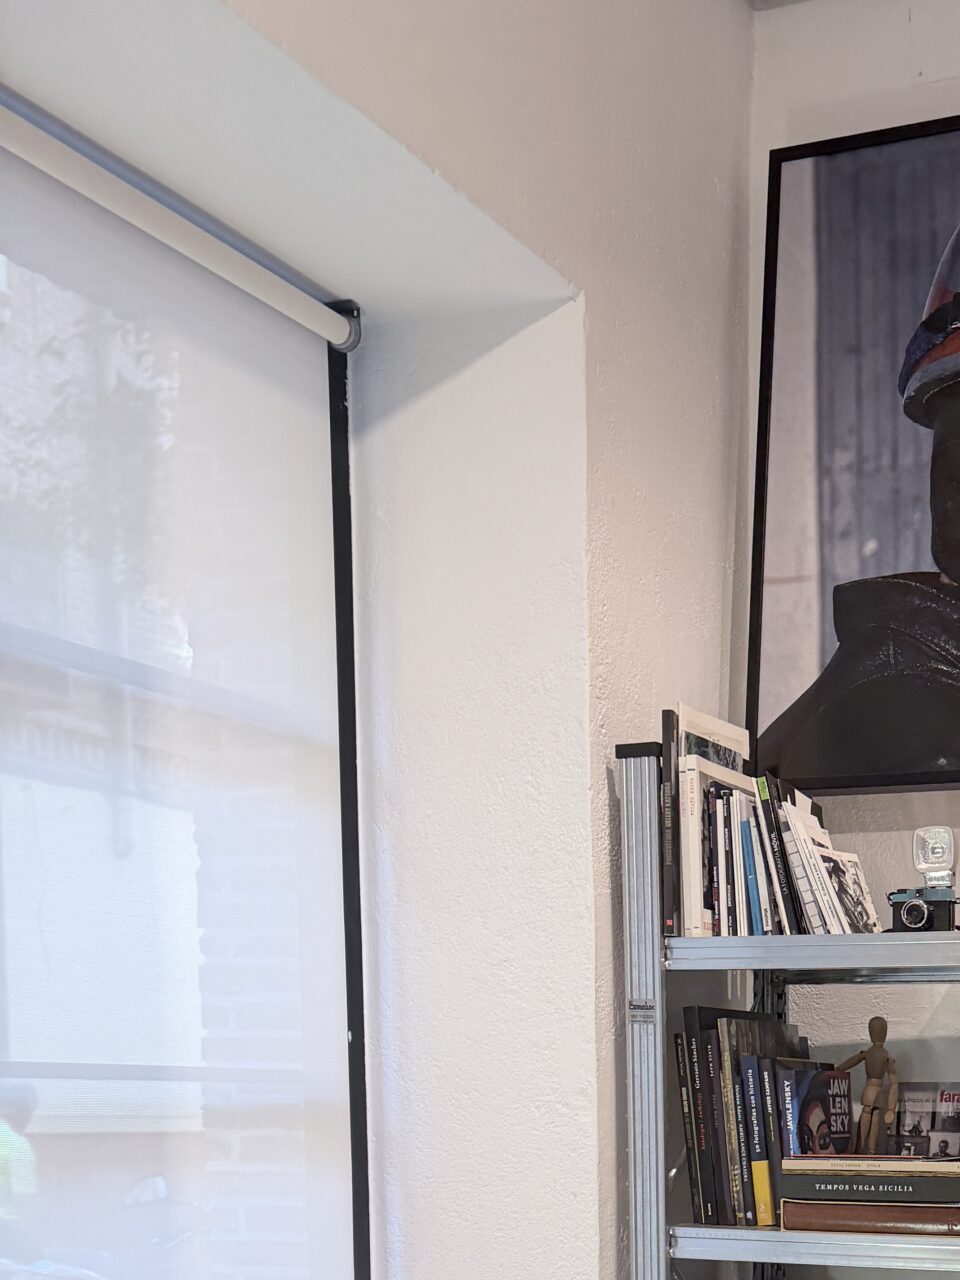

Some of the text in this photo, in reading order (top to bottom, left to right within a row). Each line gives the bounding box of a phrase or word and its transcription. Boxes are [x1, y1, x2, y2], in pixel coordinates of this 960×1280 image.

[828, 1078, 848, 1096] JAW
[784, 1080, 793, 1130] JAWLENSKY
[830, 1097, 848, 1114] LEN
[830, 1115, 849, 1132] SKY
[815, 1184, 913, 1193] TEMPOS VEGA SICILIA
